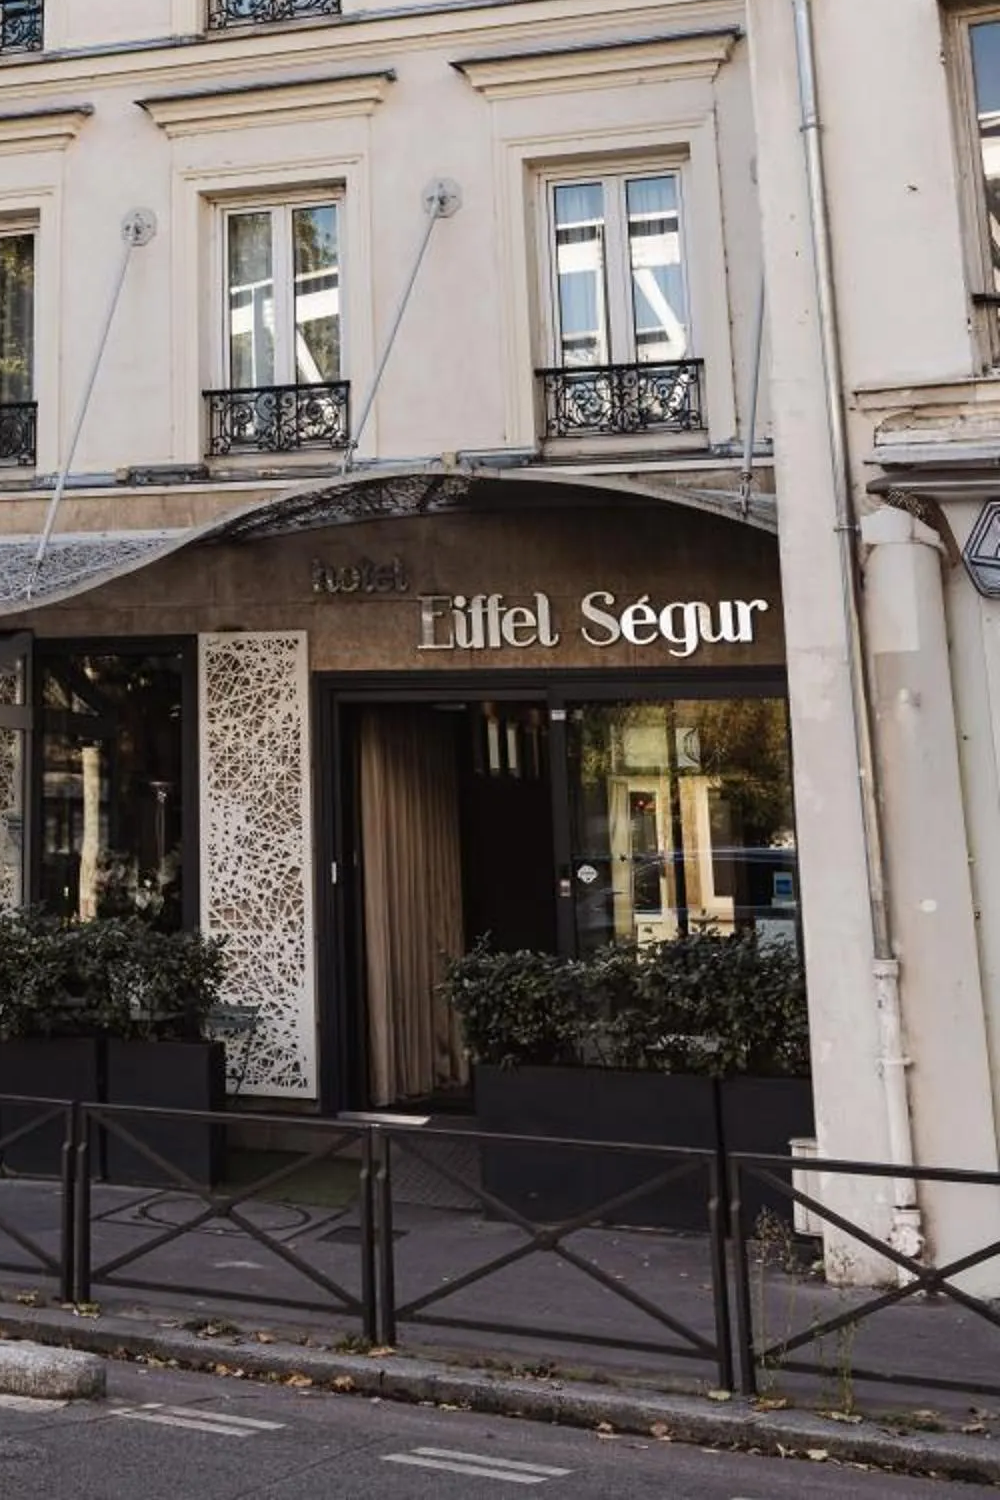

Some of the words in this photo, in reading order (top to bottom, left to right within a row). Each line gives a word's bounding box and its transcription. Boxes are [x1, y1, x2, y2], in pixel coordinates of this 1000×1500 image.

[310, 554, 410, 593] hotel
[417, 592, 559, 649] Eiffel
[581, 591, 768, 657] Ségur
